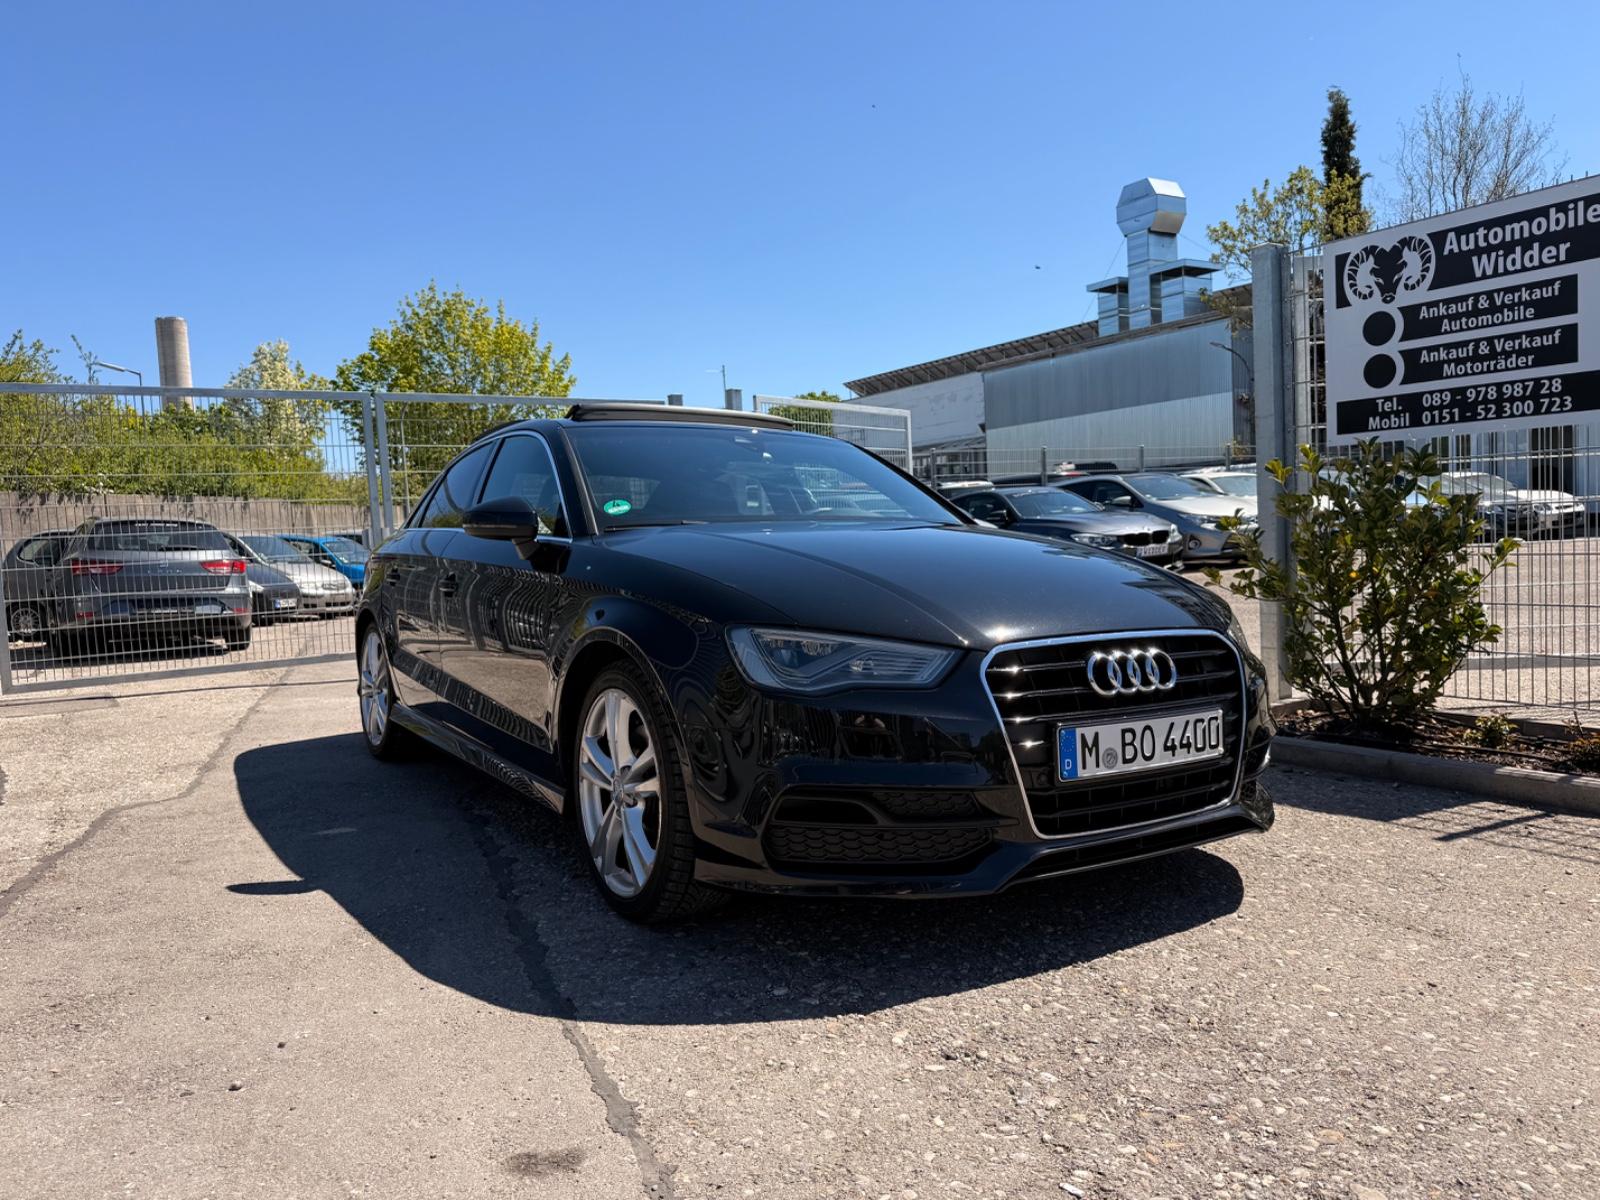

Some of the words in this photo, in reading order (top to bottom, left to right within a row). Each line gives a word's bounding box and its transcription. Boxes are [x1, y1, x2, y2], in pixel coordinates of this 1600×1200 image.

[1443, 201, 1600, 256] Automobile
[1472, 242, 1571, 278] Widder
[1419, 297, 1474, 320] Ankauf
[1477, 295, 1490, 309] &
[1493, 280, 1562, 306] Verkauf
[1441, 305, 1535, 333] Automobile
[1420, 342, 1475, 364] Ankauf
[1478, 341, 1490, 355] &
[1494, 329, 1562, 351] Verkauf
[1442, 353, 1535, 377] Motorräder
[1376, 398, 1402, 413] Tel.
[1422, 391, 1451, 408] 089
[1466, 386, 1497, 402] 978
[1502, 381, 1535, 398] 987
[1540, 378, 1562, 394] 28
[1368, 413, 1410, 431] Mobil
[1422, 408, 1460, 425] 0151
[1476, 404, 1497, 420] 52
[1502, 400, 1534, 417] 300
[1540, 396, 1573, 413] 723
[1080, 731, 1100, 770] M
[1121, 724, 1156, 765] BO
[1163, 716, 1220, 758] 4400
[1064, 759, 1072, 771] D
